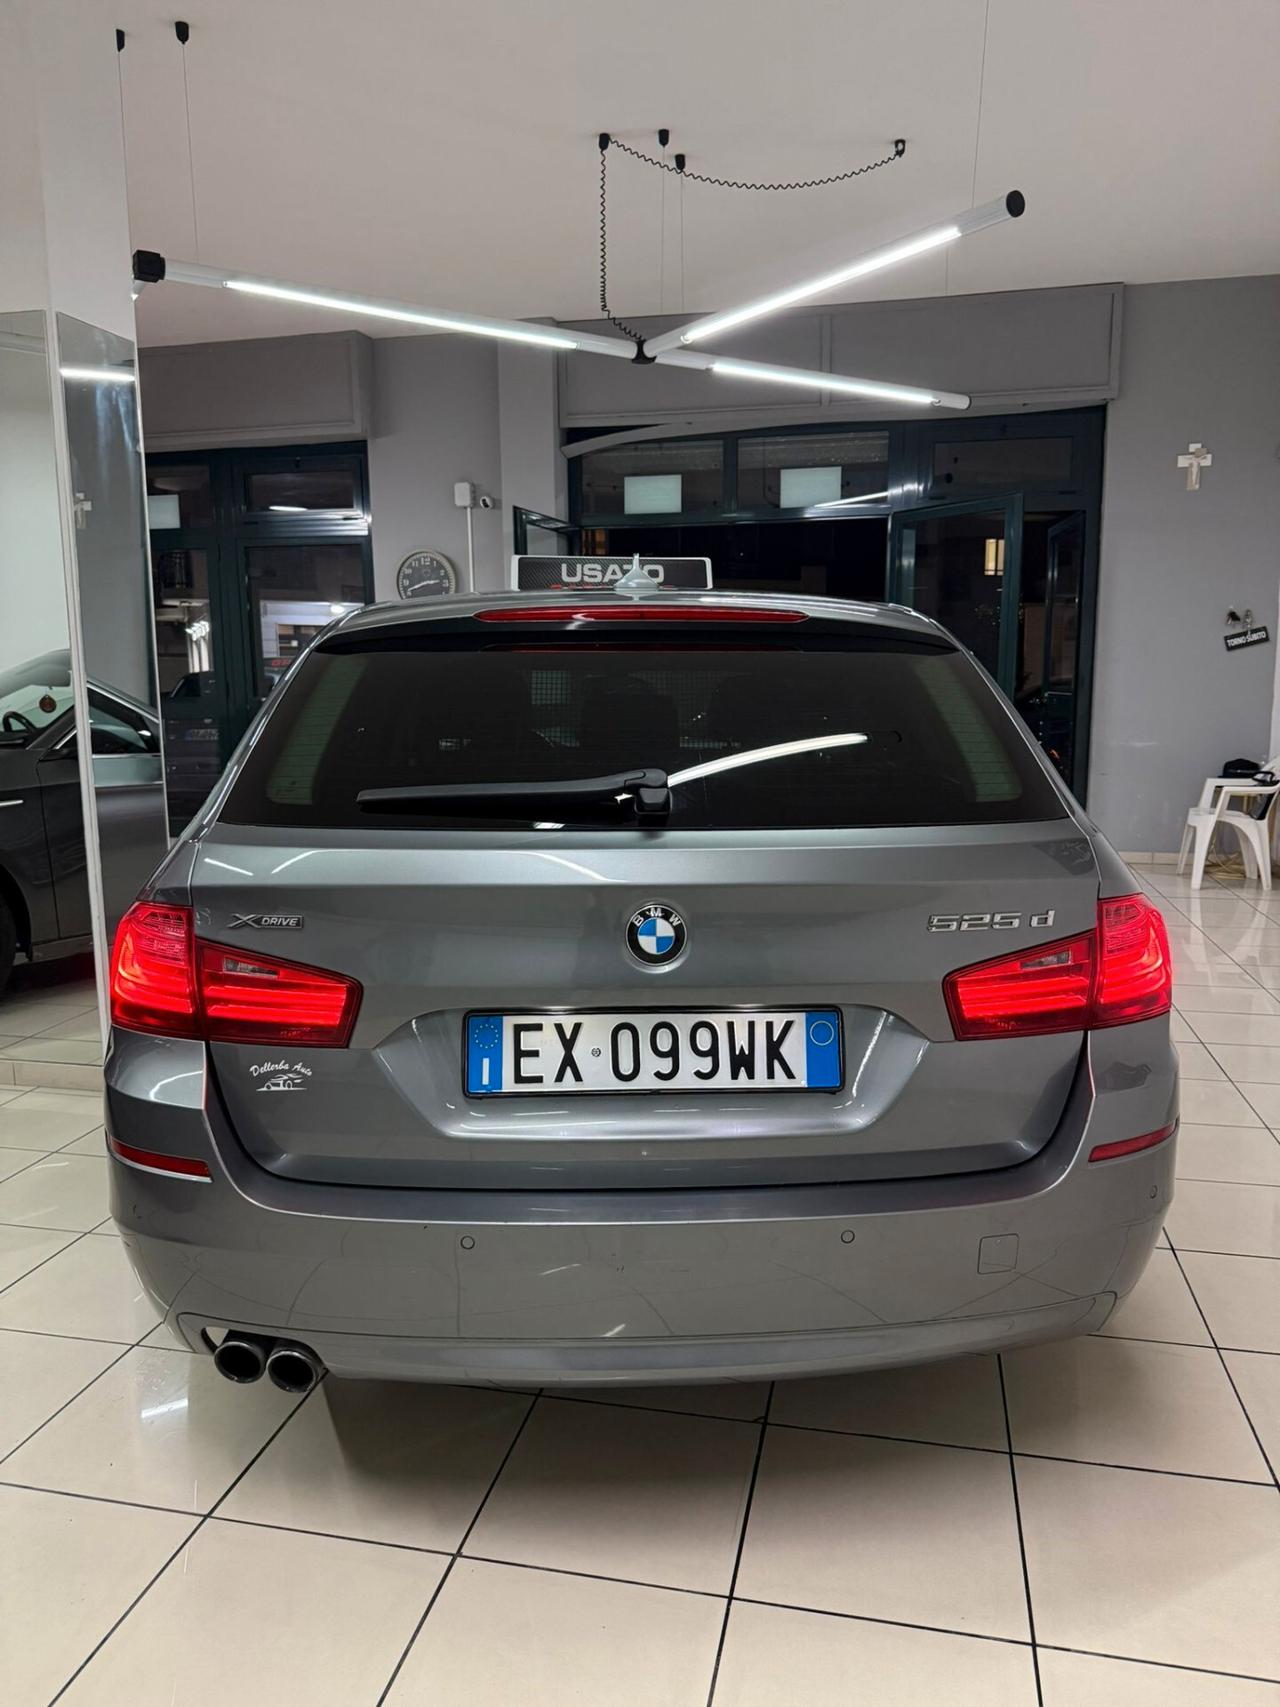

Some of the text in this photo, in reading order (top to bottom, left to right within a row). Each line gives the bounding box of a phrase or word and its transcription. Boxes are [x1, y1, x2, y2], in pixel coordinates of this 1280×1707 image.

[1227, 636, 1246, 647] TORNO
[632, 907, 681, 927] BMW
[928, 910, 1056, 932] 525 d
[513, 1021, 584, 1084] EX
[609, 1019, 797, 1082] 099WK
[249, 1060, 312, 1077] Dellerba Auto
